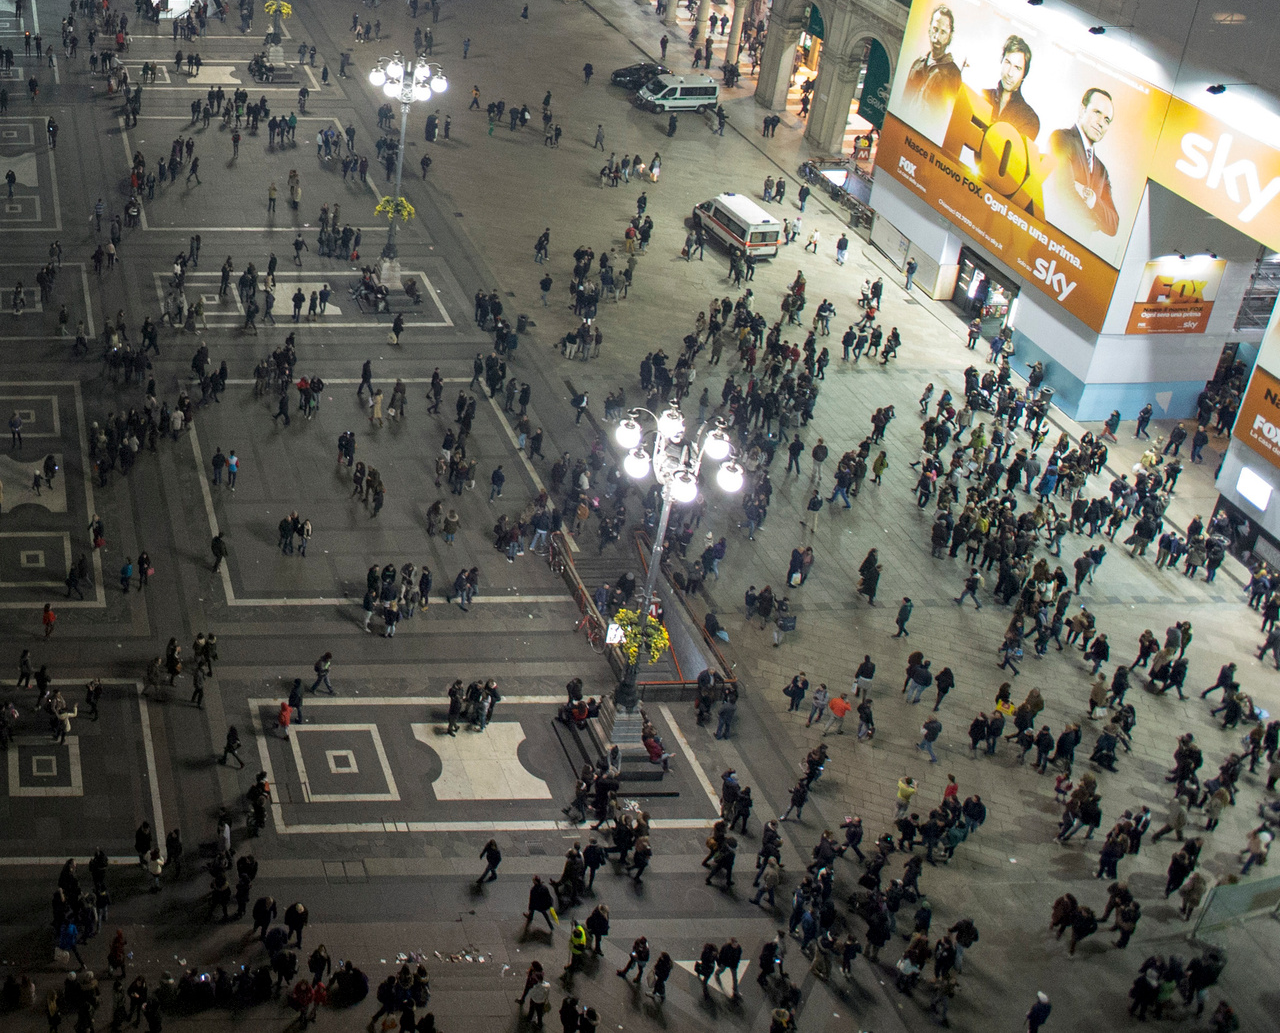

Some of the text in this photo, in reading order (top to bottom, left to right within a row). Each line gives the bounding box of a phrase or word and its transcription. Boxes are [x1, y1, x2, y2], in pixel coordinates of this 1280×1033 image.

[858, 150, 869, 158] M
[942, 82, 1057, 224] FOX
[898, 155, 917, 177] FOX
[1175, 132, 1280, 223] sky
[904, 135, 1083, 271] Nasce il nuovo FOX. Ogni sera una prima.
[1032, 257, 1078, 302] sky
[1146, 275, 1208, 303] FOX
[1141, 311, 1157, 319] Ogni
[1183, 320, 1199, 330] sky
[1249, 429, 1258, 439] La
[1257, 436, 1272, 450] casa
